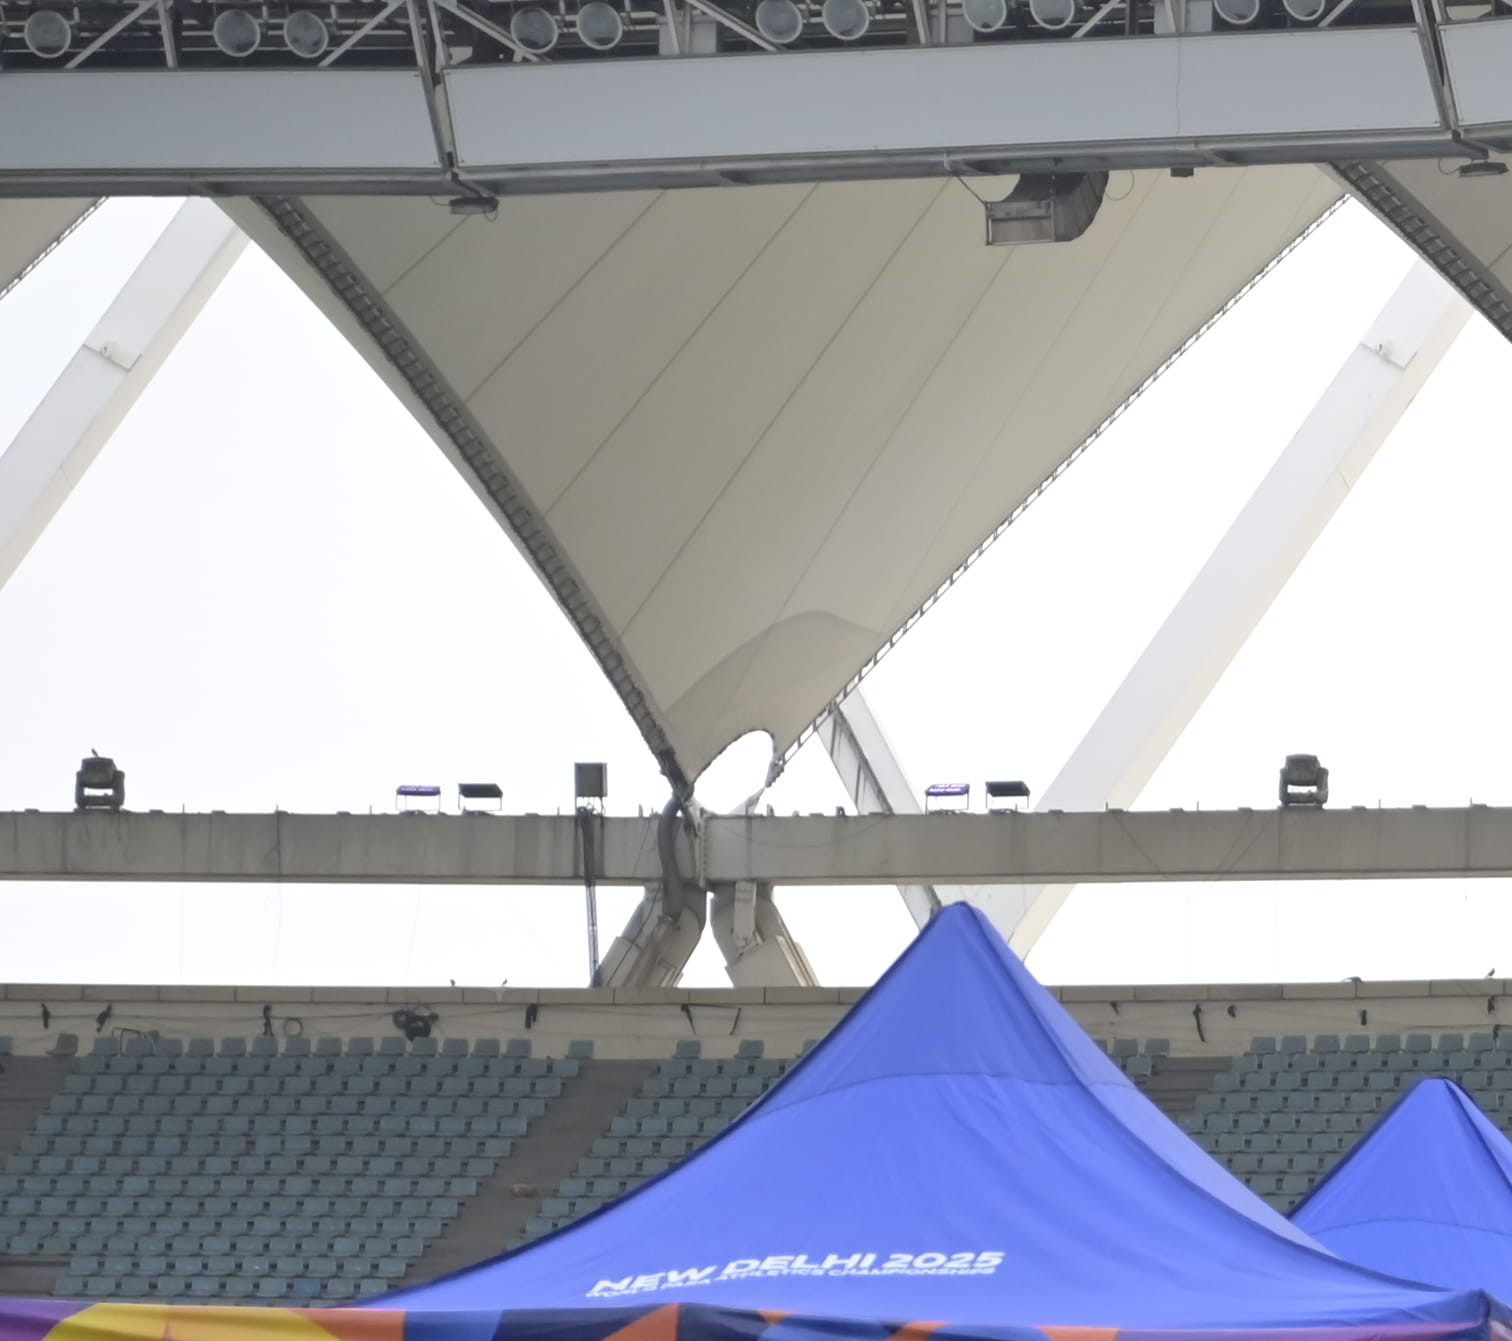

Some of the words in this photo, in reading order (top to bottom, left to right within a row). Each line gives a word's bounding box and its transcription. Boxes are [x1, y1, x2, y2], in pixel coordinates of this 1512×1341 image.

[586, 1265, 717, 1293] NEW
[721, 1253, 877, 1276] DELHI
[882, 1251, 1005, 1269] 2025
